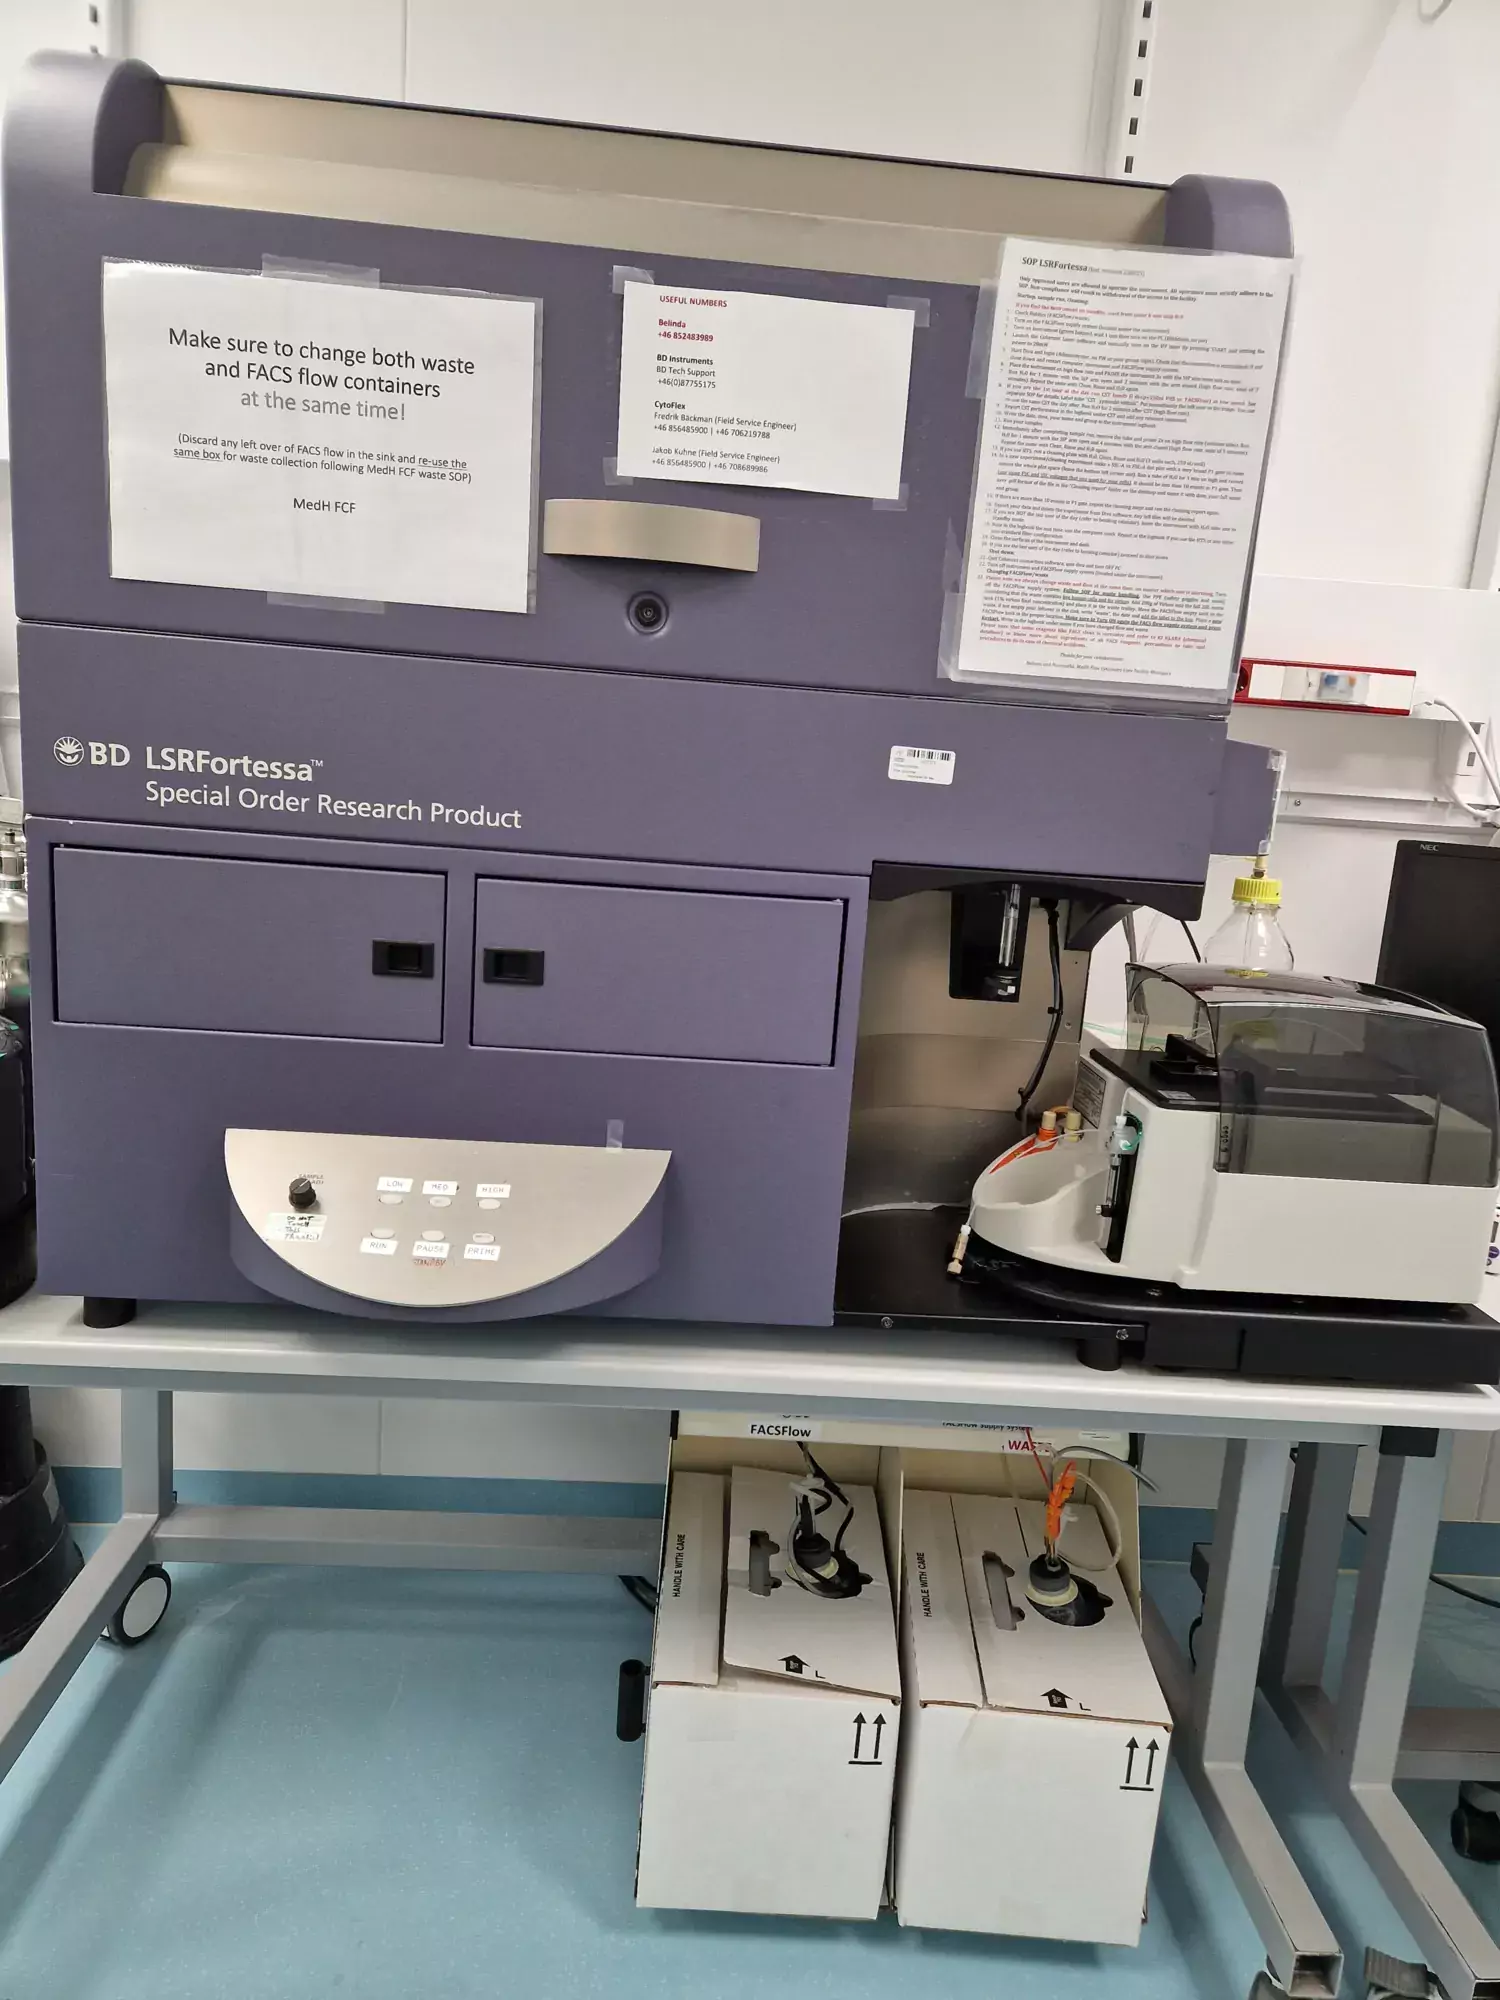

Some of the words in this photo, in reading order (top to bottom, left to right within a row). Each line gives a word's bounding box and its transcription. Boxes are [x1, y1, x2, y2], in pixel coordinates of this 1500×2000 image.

[1022, 257, 1038, 265] SOP
[1039, 259, 1087, 271] LSRFortessa
[659, 295, 687, 304] USEFUL
[689, 297, 727, 307] NUMBERS
[658, 318, 686, 328] Belinda
[169, 327, 220, 349] Make
[227, 337, 267, 354] sure
[273, 339, 293, 356] to
[299, 341, 365, 366] change
[372, 347, 414, 368] both
[421, 357, 474, 374] waste
[656, 353, 667, 361] BD
[669, 355, 713, 365] Instruments
[205, 360, 239, 378] and
[247, 362, 292, 383] FACS
[297, 367, 338, 387] flow
[344, 376, 440, 397] containers
[656, 365, 666, 373] BD
[668, 366, 685, 374] Tech
[687, 367, 715, 377] Support
[240, 390, 259, 406] at
[264, 390, 296, 410] the
[301, 398, 350, 415] same
[355, 400, 404, 420] time!
[654, 400, 685, 409] CytoFlex
[654, 411, 678, 420] Fredrik
[714, 415, 734, 424] (Field
[735, 417, 761, 426] Service
[762, 419, 796, 431] Engineer)
[654, 423, 666, 431] +46
[178, 432, 217, 445] (Discard
[220, 439, 238, 449] any
[240, 439, 257, 449] left
[259, 443, 281, 451] over
[284, 443, 294, 453] of
[297, 444, 320, 455] FACS
[323, 446, 344, 457] flow
[346, 449, 355, 458] in
[357, 450, 373, 460] the
[376, 451, 395, 462] sink
[397, 454, 415, 463] and
[418, 457, 447, 469] re-use
[448, 458, 466, 470] the
[652, 446, 672, 454] Jakob
[698, 449, 718, 457] (Field
[719, 450, 744, 459] Service
[746, 452, 780, 464] Engineer)
[173, 448, 199, 459] same
[200, 448, 220, 461] box
[222, 450, 236, 460] for
[239, 454, 268, 464] waste
[270, 456, 317, 468] collection
[320, 459, 363, 474] following
[366, 464, 395, 475] MedH
[398, 466, 415, 476] FCF
[418, 470, 446, 480] waste
[448, 471, 471, 484] SOP)
[293, 497, 330, 511] MedH
[334, 501, 355, 513] FCF
[88, 741, 130, 766] BD
[146, 780, 229, 806] Special
[238, 787, 309, 812] Order
[318, 793, 421, 820] Research
[431, 802, 521, 828] Product
[1420, 843, 1439, 851] NEC
[386, 1180, 403, 1188] LOW
[431, 1183, 449, 1191] MED
[369, 1241, 388, 1249] RUN
[416, 1245, 445, 1253] PAUSE
[467, 1248, 496, 1256] PRIME
[750, 1424, 812, 1437] FACSFlow
[676, 1534, 686, 1551] CARE
[675, 1552, 684, 1569] WITH
[916, 1552, 926, 1570] CARE
[672, 1570, 683, 1598] HANDLE
[917, 1571, 928, 1588] WITH
[921, 1589, 932, 1618] HANDLE
